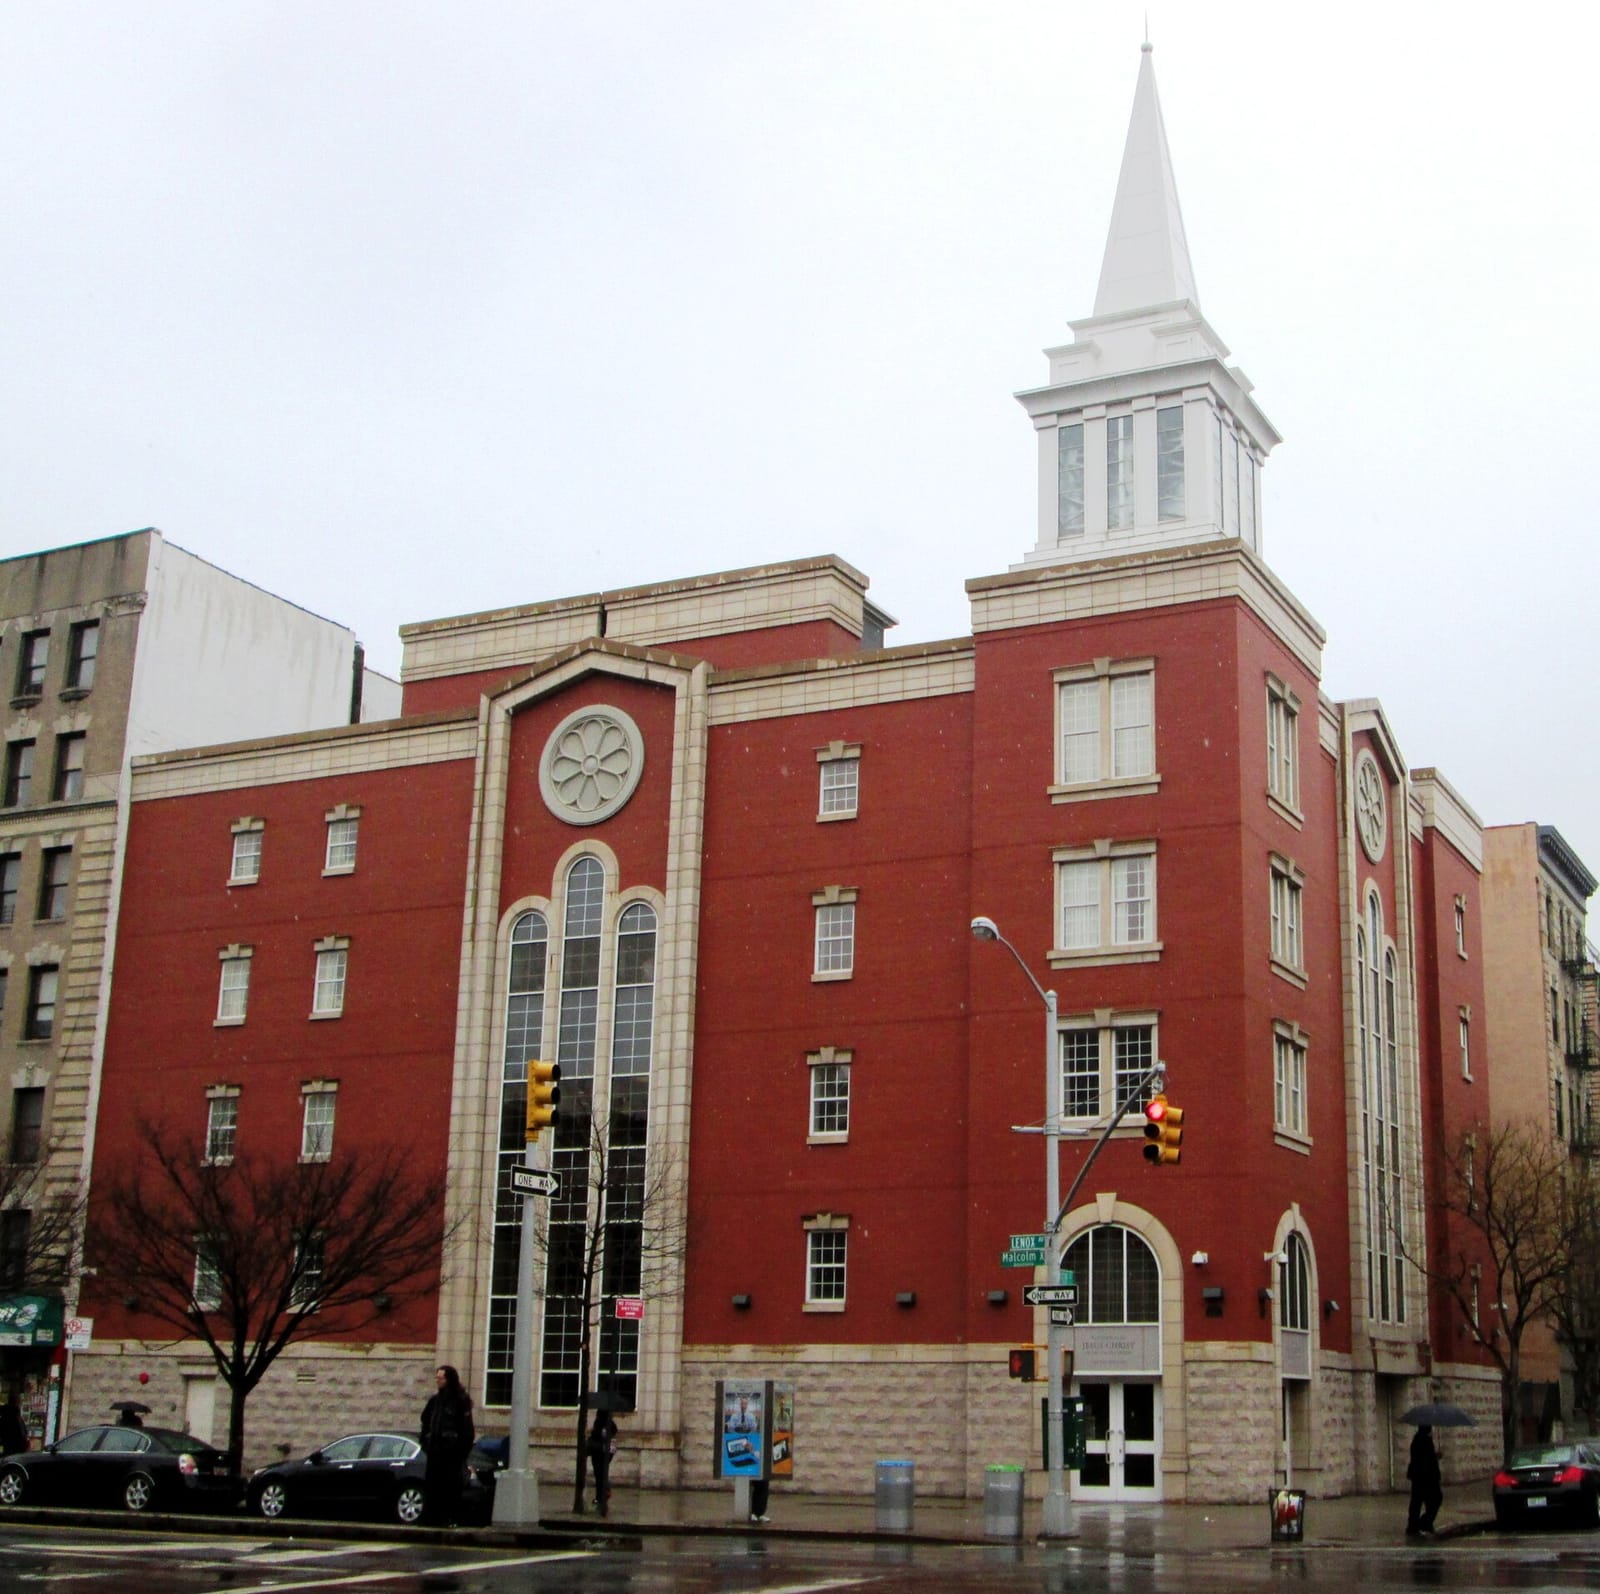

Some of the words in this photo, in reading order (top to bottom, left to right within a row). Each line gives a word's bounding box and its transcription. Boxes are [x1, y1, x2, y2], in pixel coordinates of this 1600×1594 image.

[519, 1174, 533, 1187] ONE
[538, 1179, 554, 1191] WAY
[1011, 1236, 1035, 1249] LENOX
[1002, 1251, 1036, 1263] Malcolm
[1031, 1292, 1047, 1300] ONE
[1054, 1291, 1071, 1300] WAY
